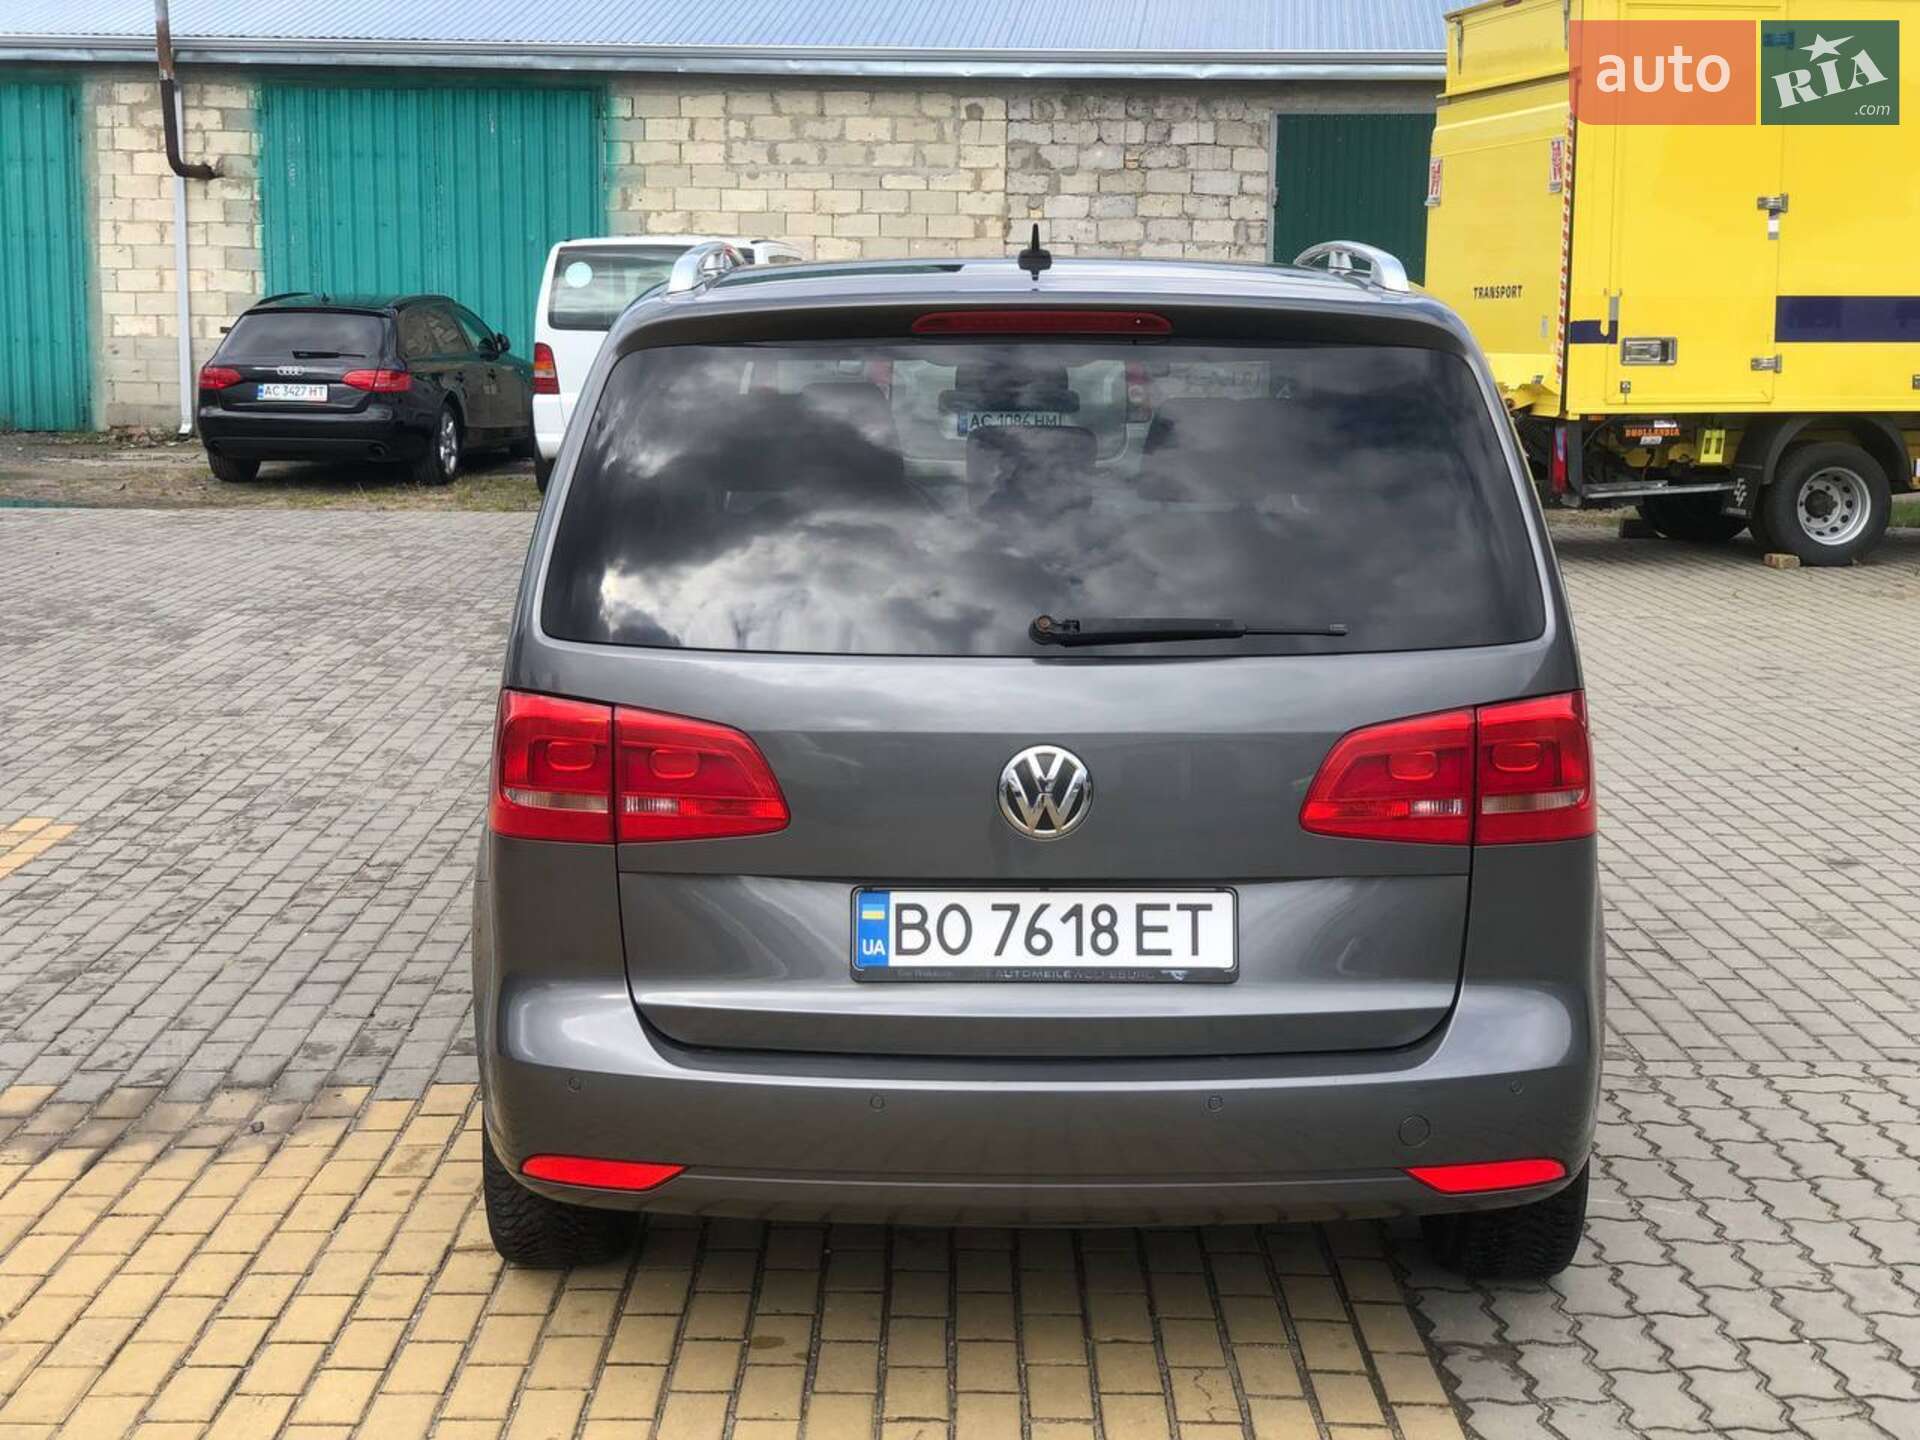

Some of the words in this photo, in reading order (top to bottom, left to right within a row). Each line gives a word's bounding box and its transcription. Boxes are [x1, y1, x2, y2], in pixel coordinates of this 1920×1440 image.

[1473, 285, 1523, 299] TRANSPORT
[265, 385, 280, 397] AC
[282, 385, 307, 397] 3427
[309, 386, 325, 397] HT
[969, 413, 993, 429] AC
[862, 938, 886, 956] UA
[895, 903, 973, 957] BO
[991, 903, 1119, 957] 7618
[1136, 903, 1213, 957] ET
